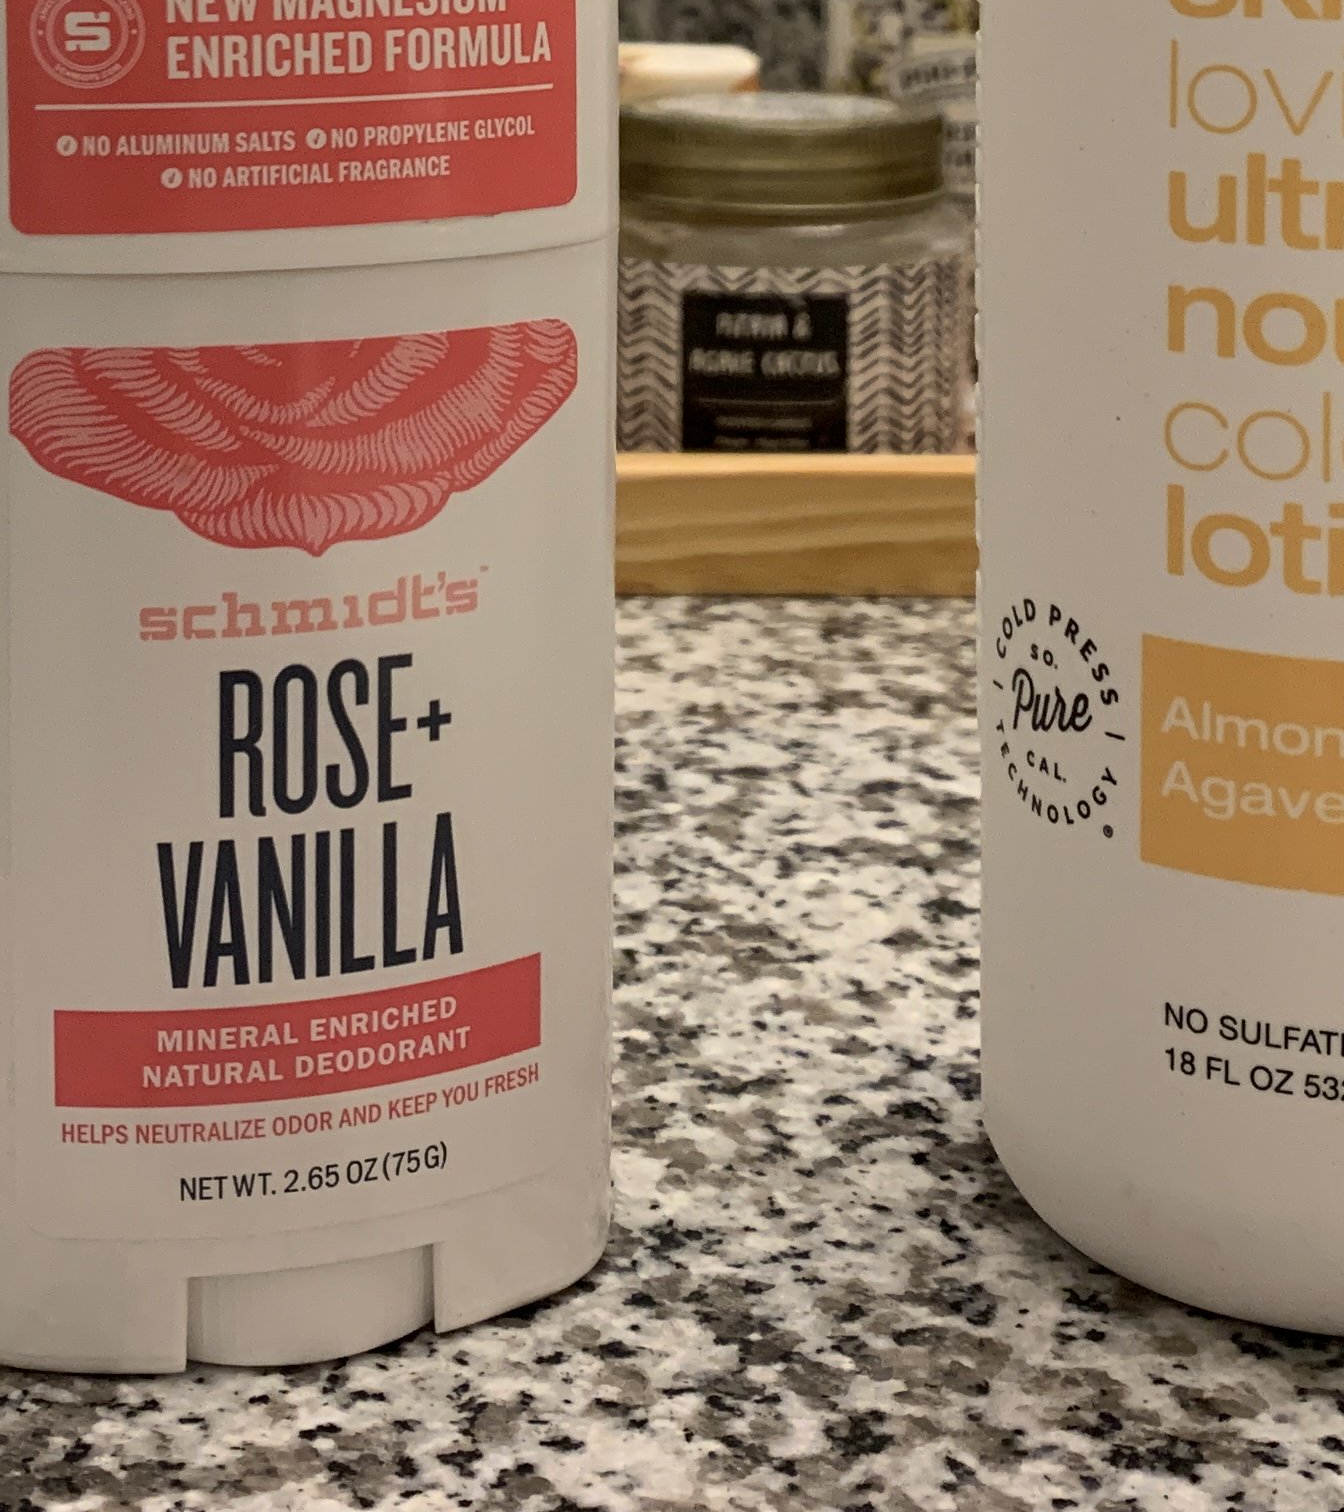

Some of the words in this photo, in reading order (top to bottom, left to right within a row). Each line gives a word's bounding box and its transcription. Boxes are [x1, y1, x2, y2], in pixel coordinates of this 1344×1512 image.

[167, 27, 373, 81] ENRICHED
[385, 21, 552, 72] FORMULA
[82, 134, 111, 157] NO
[116, 132, 231, 156] ALUMINUM
[235, 129, 296, 153] SALTS
[331, 126, 358, 149] NO
[364, 118, 470, 147] PROPYLENE
[474, 115, 536, 140] GLYCOL
[188, 168, 218, 189] NO
[222, 162, 334, 188] ARTIFICIAL
[339, 155, 451, 184] FRAGRANCE
[995, 598, 1036, 660] COLD
[1048, 603, 1120, 707] PRESS
[1030, 643, 1059, 670] SO.
[1011, 667, 1094, 733] Pure
[995, 718, 1119, 826] TECHNOLOGY
[1025, 749, 1068, 784] CAL.
[156, 811, 464, 989] VANILLA
[157, 1022, 298, 1055] MINERAL
[309, 995, 458, 1043] ENRICHED
[1163, 1002, 1209, 1036] NO
[141, 1057, 284, 1090] NATURAL
[294, 1025, 472, 1080] DEODORANT
[1163, 1047, 1197, 1076] 18
[1205, 1057, 1241, 1088] FL
[1249, 1066, 1294, 1096] OZ
[61, 1122, 129, 1146] HELPS
[135, 1117, 267, 1146] NEUTRALIZE
[271, 1110, 333, 1138] ODOR
[338, 1102, 383, 1130] AND
[387, 1091, 438, 1122] KEEP
[441, 1080, 480, 1109] YOU
[483, 1062, 540, 1100] FRESH
[179, 1175, 229, 1202] NET
[232, 1172, 278, 1198] WT.
[283, 1163, 341, 1195] 2.65
[345, 1157, 379, 1186] OZ
[382, 1139, 450, 1182] (75G)
